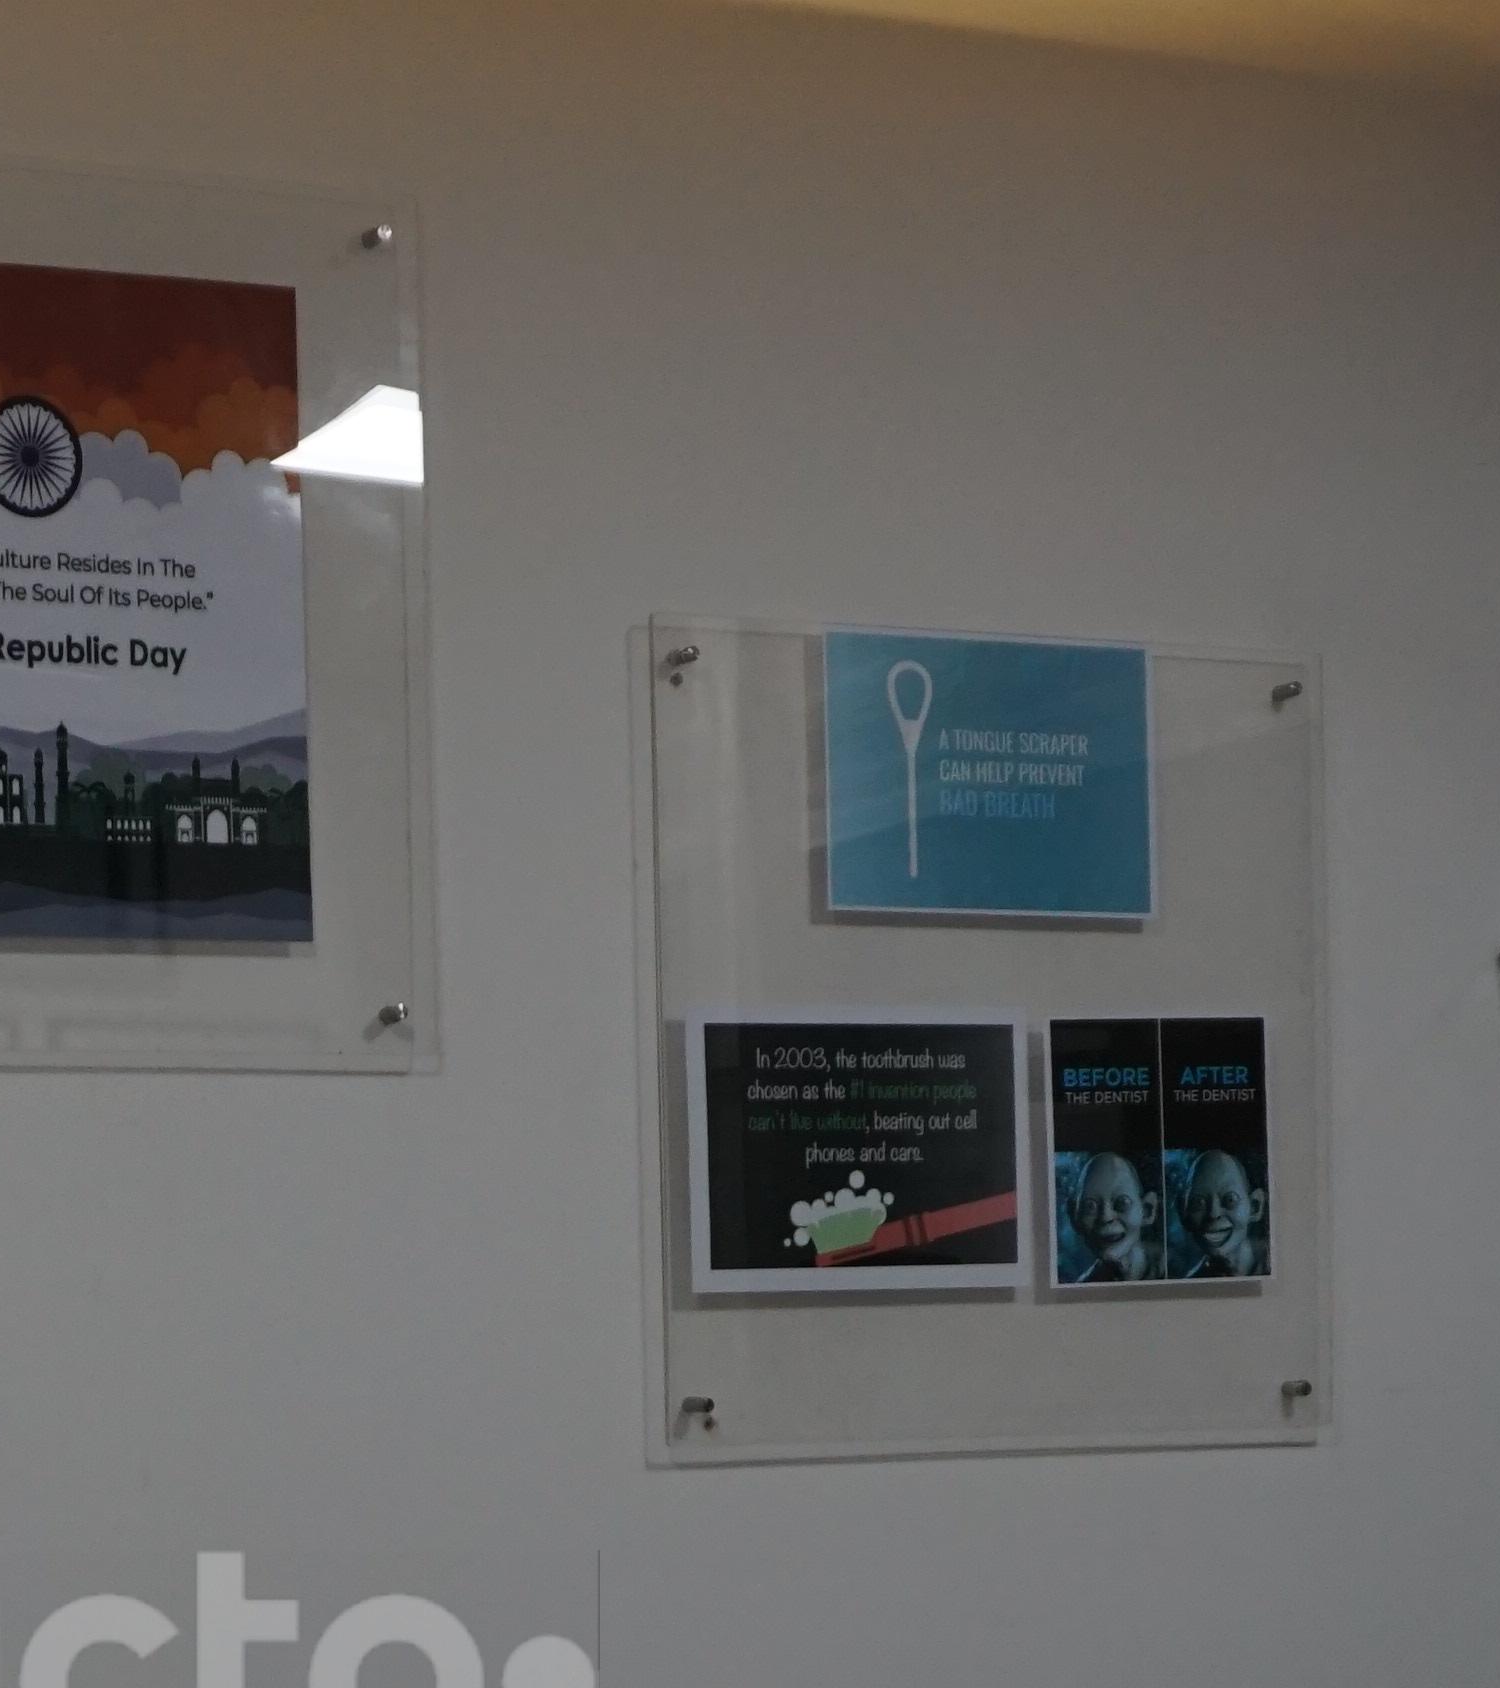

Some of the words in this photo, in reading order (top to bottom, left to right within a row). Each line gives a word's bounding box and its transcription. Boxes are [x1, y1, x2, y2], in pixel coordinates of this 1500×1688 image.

[57, 554, 131, 575] Resides
[138, 557, 154, 577] In
[161, 559, 195, 579] The
[32, 583, 74, 604] Soul
[80, 585, 105, 605] Of
[109, 587, 131, 607] Its
[129, 638, 187, 675] Day
[938, 728, 950, 751] A
[954, 729, 1016, 753] TONGUE
[1019, 732, 1089, 757] SCRAPER
[939, 759, 971, 782] CAN
[976, 760, 1014, 784] HELP
[1018, 763, 1085, 787] PREVENT
[756, 1048, 770, 1069] In
[774, 1047, 831, 1072] 2003,
[835, 1048, 857, 1068] the
[862, 1048, 934, 1069] toothbrush
[938, 1053, 966, 1069] was
[1063, 1067, 1150, 1087] BEFORE
[1180, 1066, 1248, 1085] AFTER
[747, 1079, 798, 1100] chosen
[802, 1085, 819, 1100] as
[824, 1079, 846, 1100] the
[933, 1079, 977, 1106] people
[1065, 1091, 1090, 1104] THE
[1094, 1090, 1149, 1104] DENTIST
[1174, 1089, 1198, 1102] THE
[1202, 1088, 1256, 1102] DENTIST
[874, 1112, 924, 1136] beating
[929, 1112, 951, 1130] out
[955, 1109, 977, 1130] cell
[805, 1141, 855, 1169] phones
[859, 1140, 886, 1162] and
